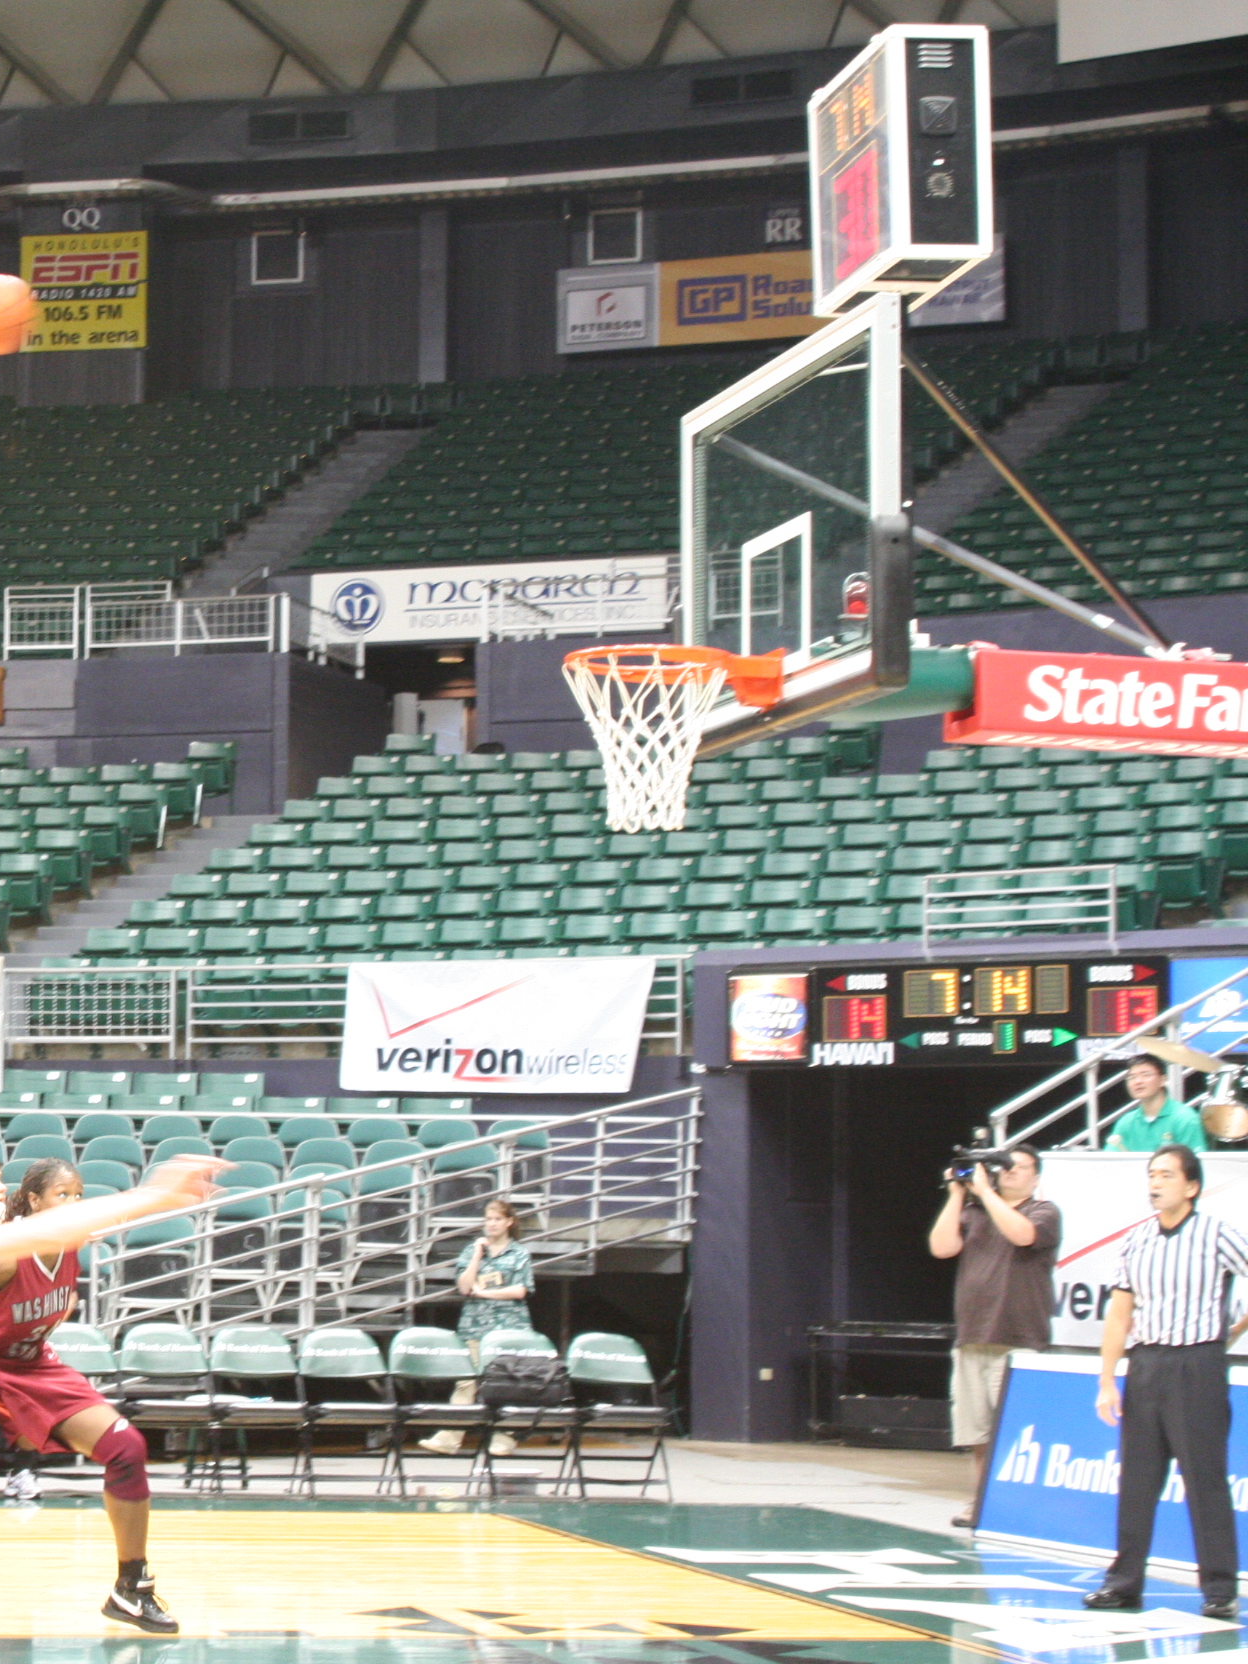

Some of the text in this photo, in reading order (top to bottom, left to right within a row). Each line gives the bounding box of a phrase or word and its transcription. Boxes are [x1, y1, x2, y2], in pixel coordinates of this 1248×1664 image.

[62, 207, 101, 231] QQ
[765, 217, 802, 243] RR
[34, 236, 140, 250] HONOLULU'S
[31, 251, 140, 284] ESPN
[31, 287, 74, 299] RADIO
[116, 285, 137, 297] AM
[689, 286, 735, 314] GP
[43, 304, 122, 321] 106.5 FM
[570, 319, 642, 332] PETERSON
[26, 330, 139, 346] in the arena
[1023, 665, 1174, 729] State
[849, 997, 886, 1040] 14
[376, 1038, 627, 1080] verizon wireless
[1043, 1443, 1122, 1494] Bank
